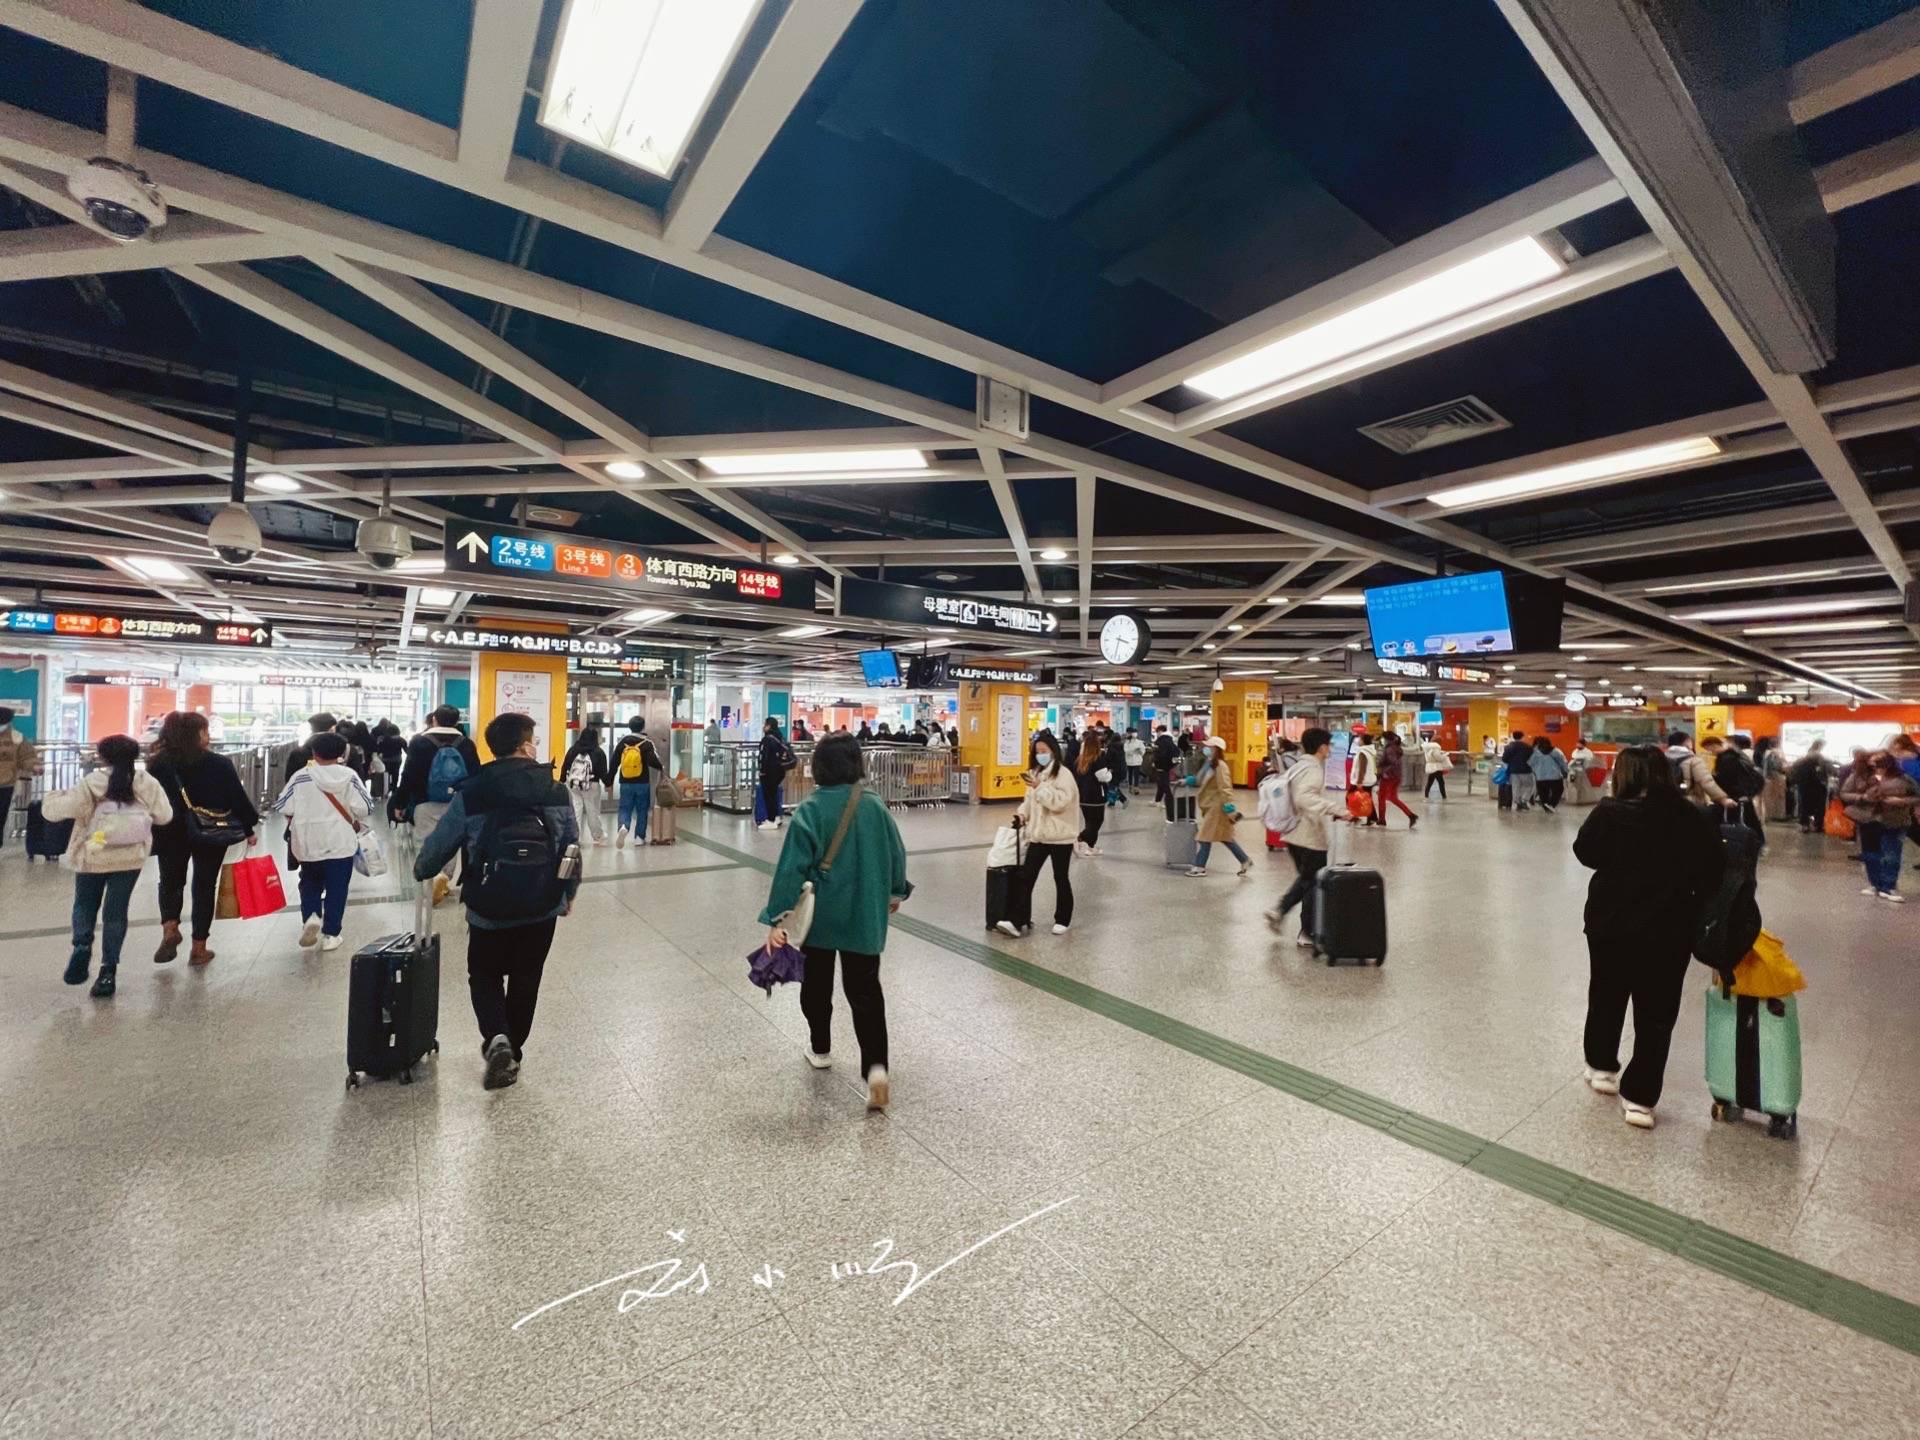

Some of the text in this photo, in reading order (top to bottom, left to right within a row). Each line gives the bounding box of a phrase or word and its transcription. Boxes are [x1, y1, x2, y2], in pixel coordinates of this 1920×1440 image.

[499, 539, 547, 560] 2号线
[498, 556, 532, 567] Line 2
[563, 549, 606, 568] 3号线
[623, 554, 635, 569] 3
[563, 564, 580, 573] Line
[646, 557, 738, 584] 体育西路方向
[646, 574, 679, 586] Towards
[740, 573, 780, 590] 14号线
[740, 585, 766, 595] Line 14
[923, 597, 960, 614] 母婴室
[978, 604, 1009, 621] 卫生间
[217, 626, 250, 637] 14号线
[444, 630, 490, 647] A.E.F
[521, 636, 550, 651] G.H
[569, 639, 610, 654] B.C.D
